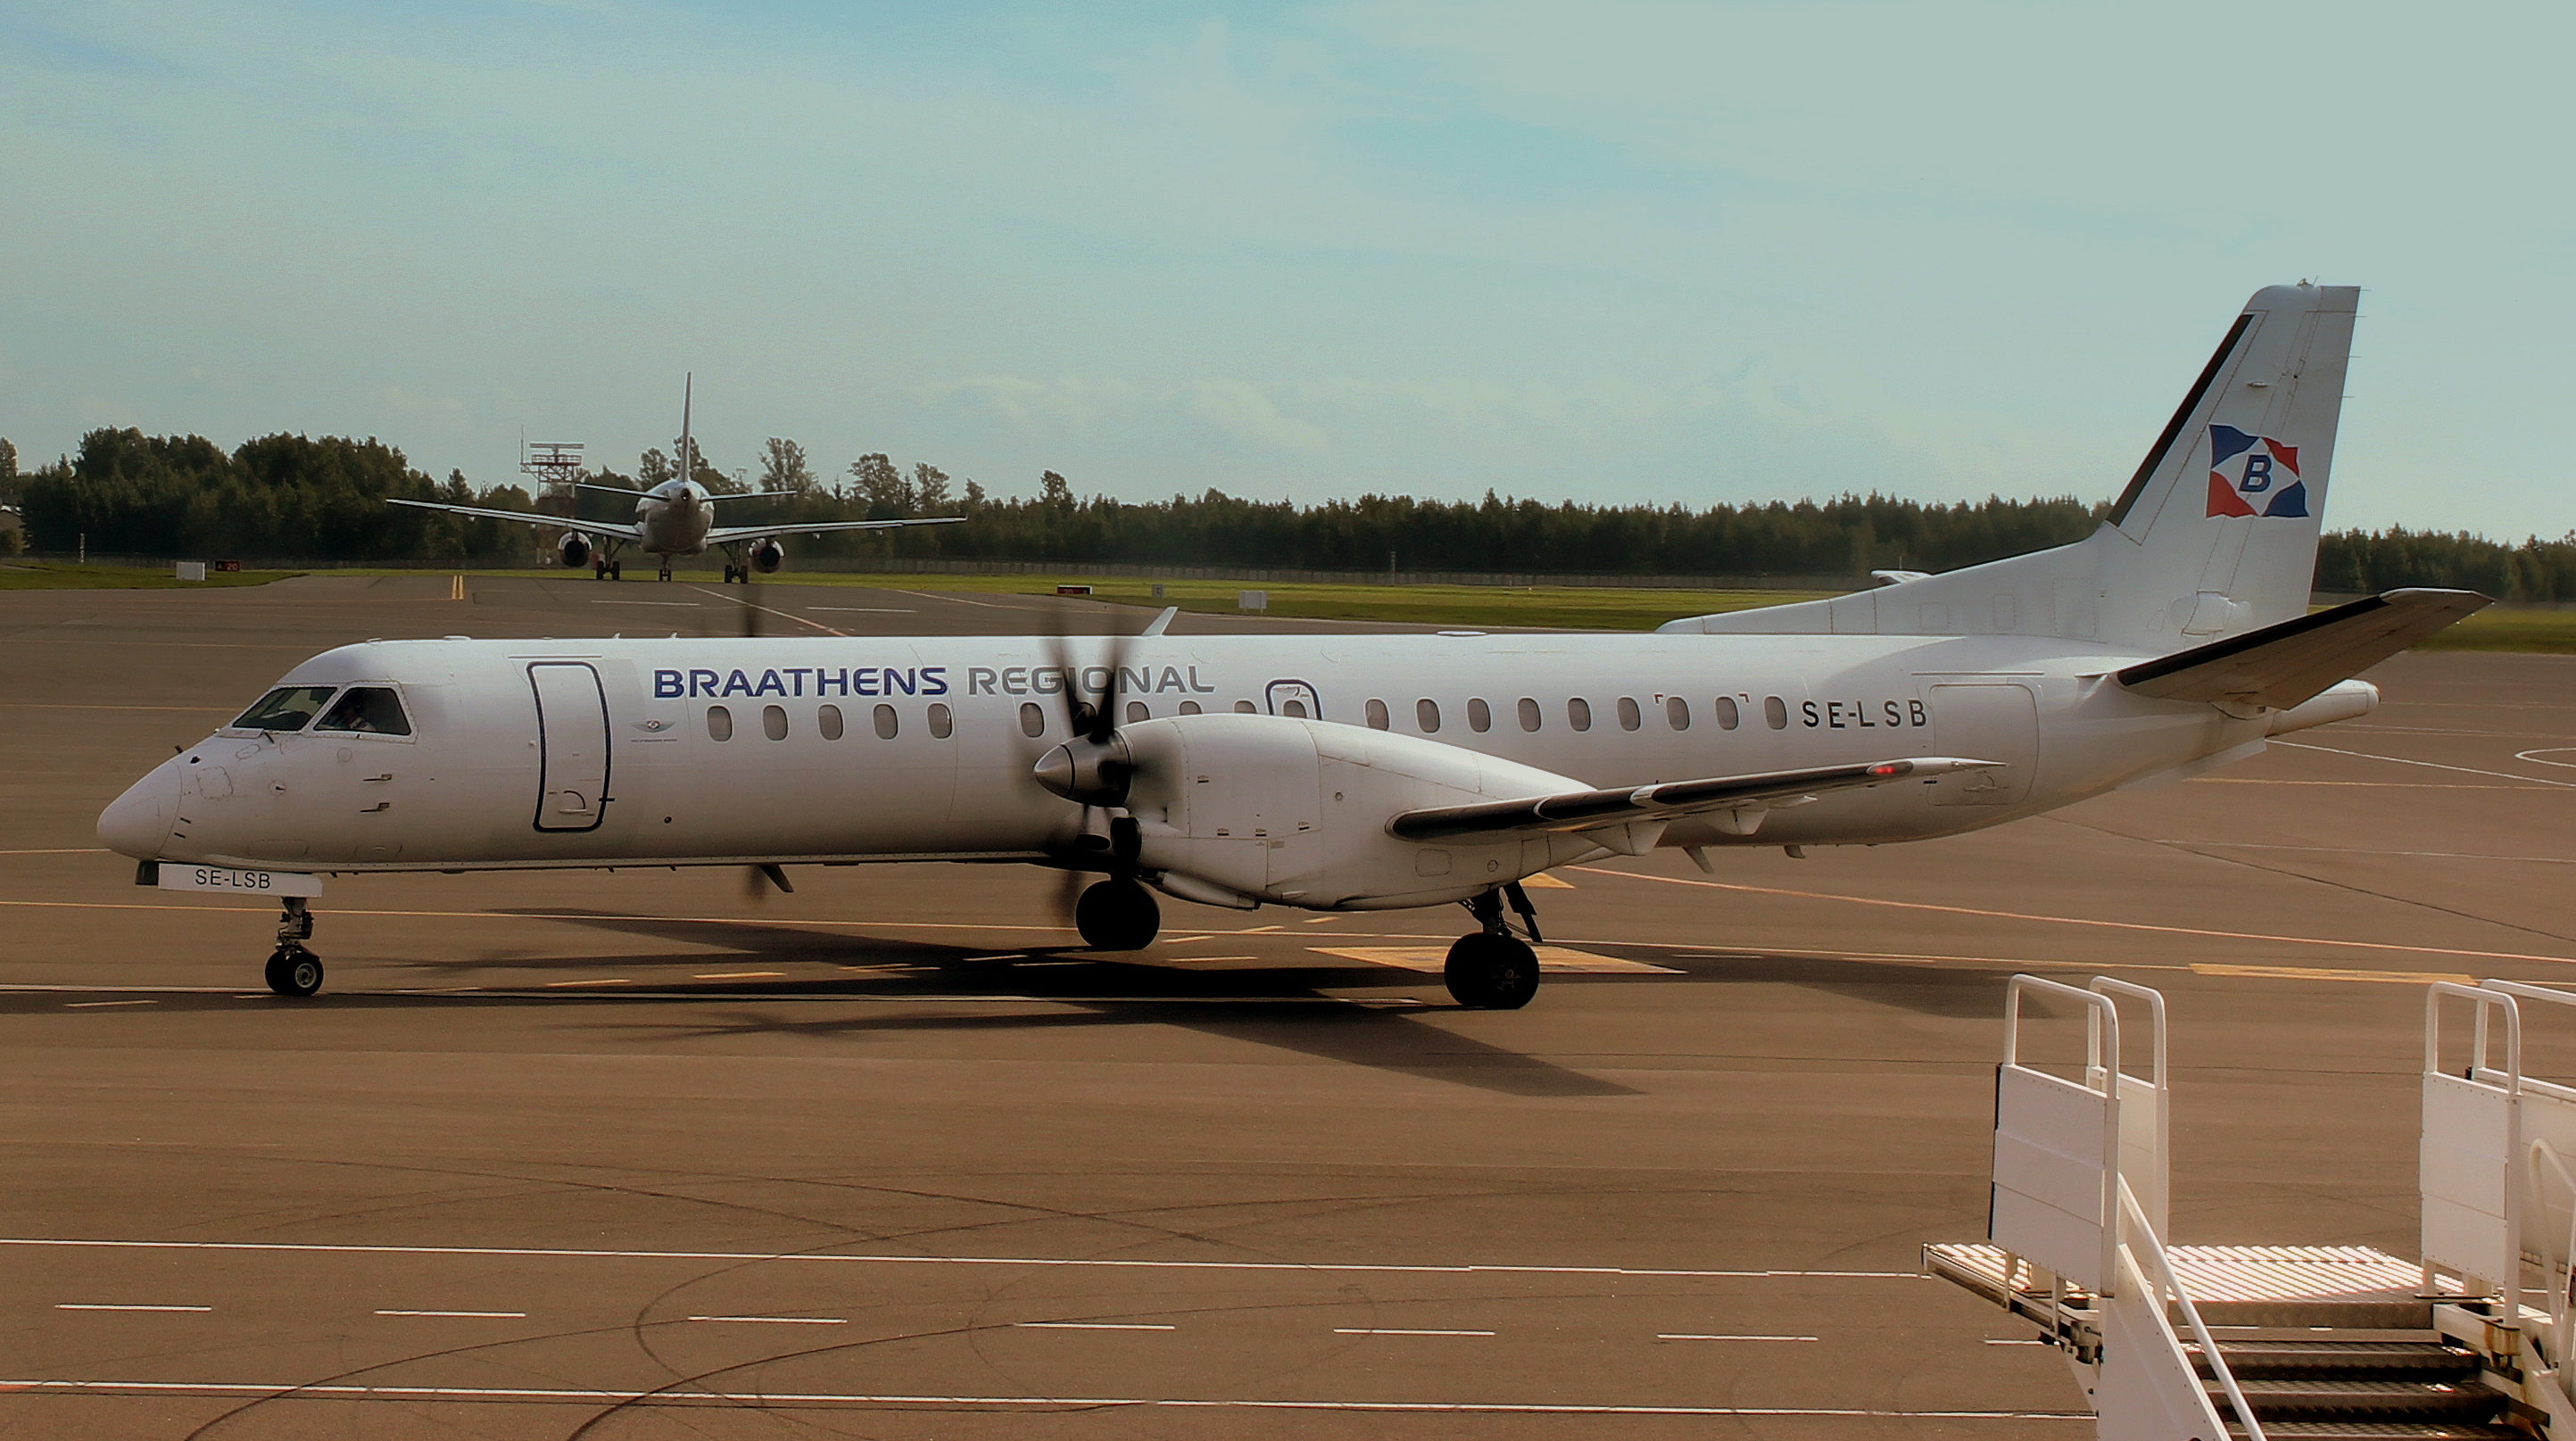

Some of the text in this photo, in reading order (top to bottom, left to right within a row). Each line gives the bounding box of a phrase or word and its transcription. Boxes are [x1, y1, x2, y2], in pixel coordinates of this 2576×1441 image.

[2237, 454, 2273, 493] B
[653, 666, 1215, 699] BRAATHENS REGIONAL
[1802, 699, 1927, 729] SE-LSB
[195, 868, 271, 890] SE-LSB
